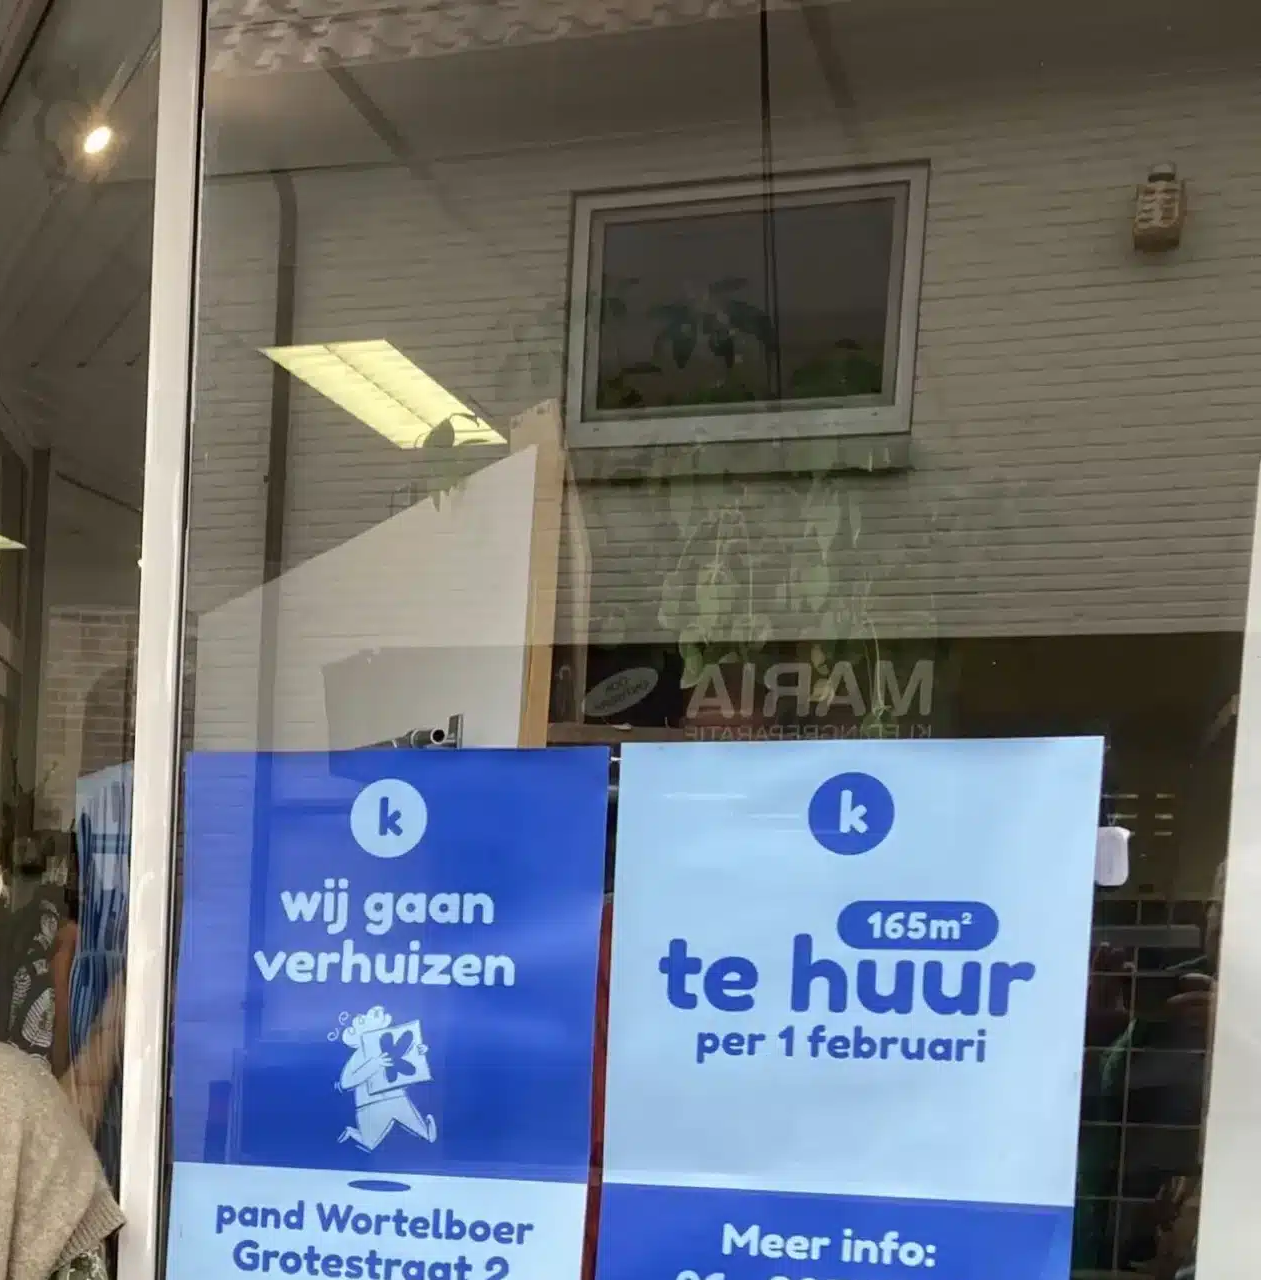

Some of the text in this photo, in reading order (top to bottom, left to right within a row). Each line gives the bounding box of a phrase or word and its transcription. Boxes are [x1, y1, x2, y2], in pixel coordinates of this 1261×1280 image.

[377, 796, 403, 838] k
[839, 789, 869, 834] k
[281, 879, 494, 935] wij gaan
[253, 938, 516, 986] verhuizen
[658, 933, 1036, 1017] te huur
[696, 1024, 986, 1065] per 1 februari
[215, 1199, 534, 1247] pand Wortelboer
[722, 1223, 936, 1268] Meer info:
